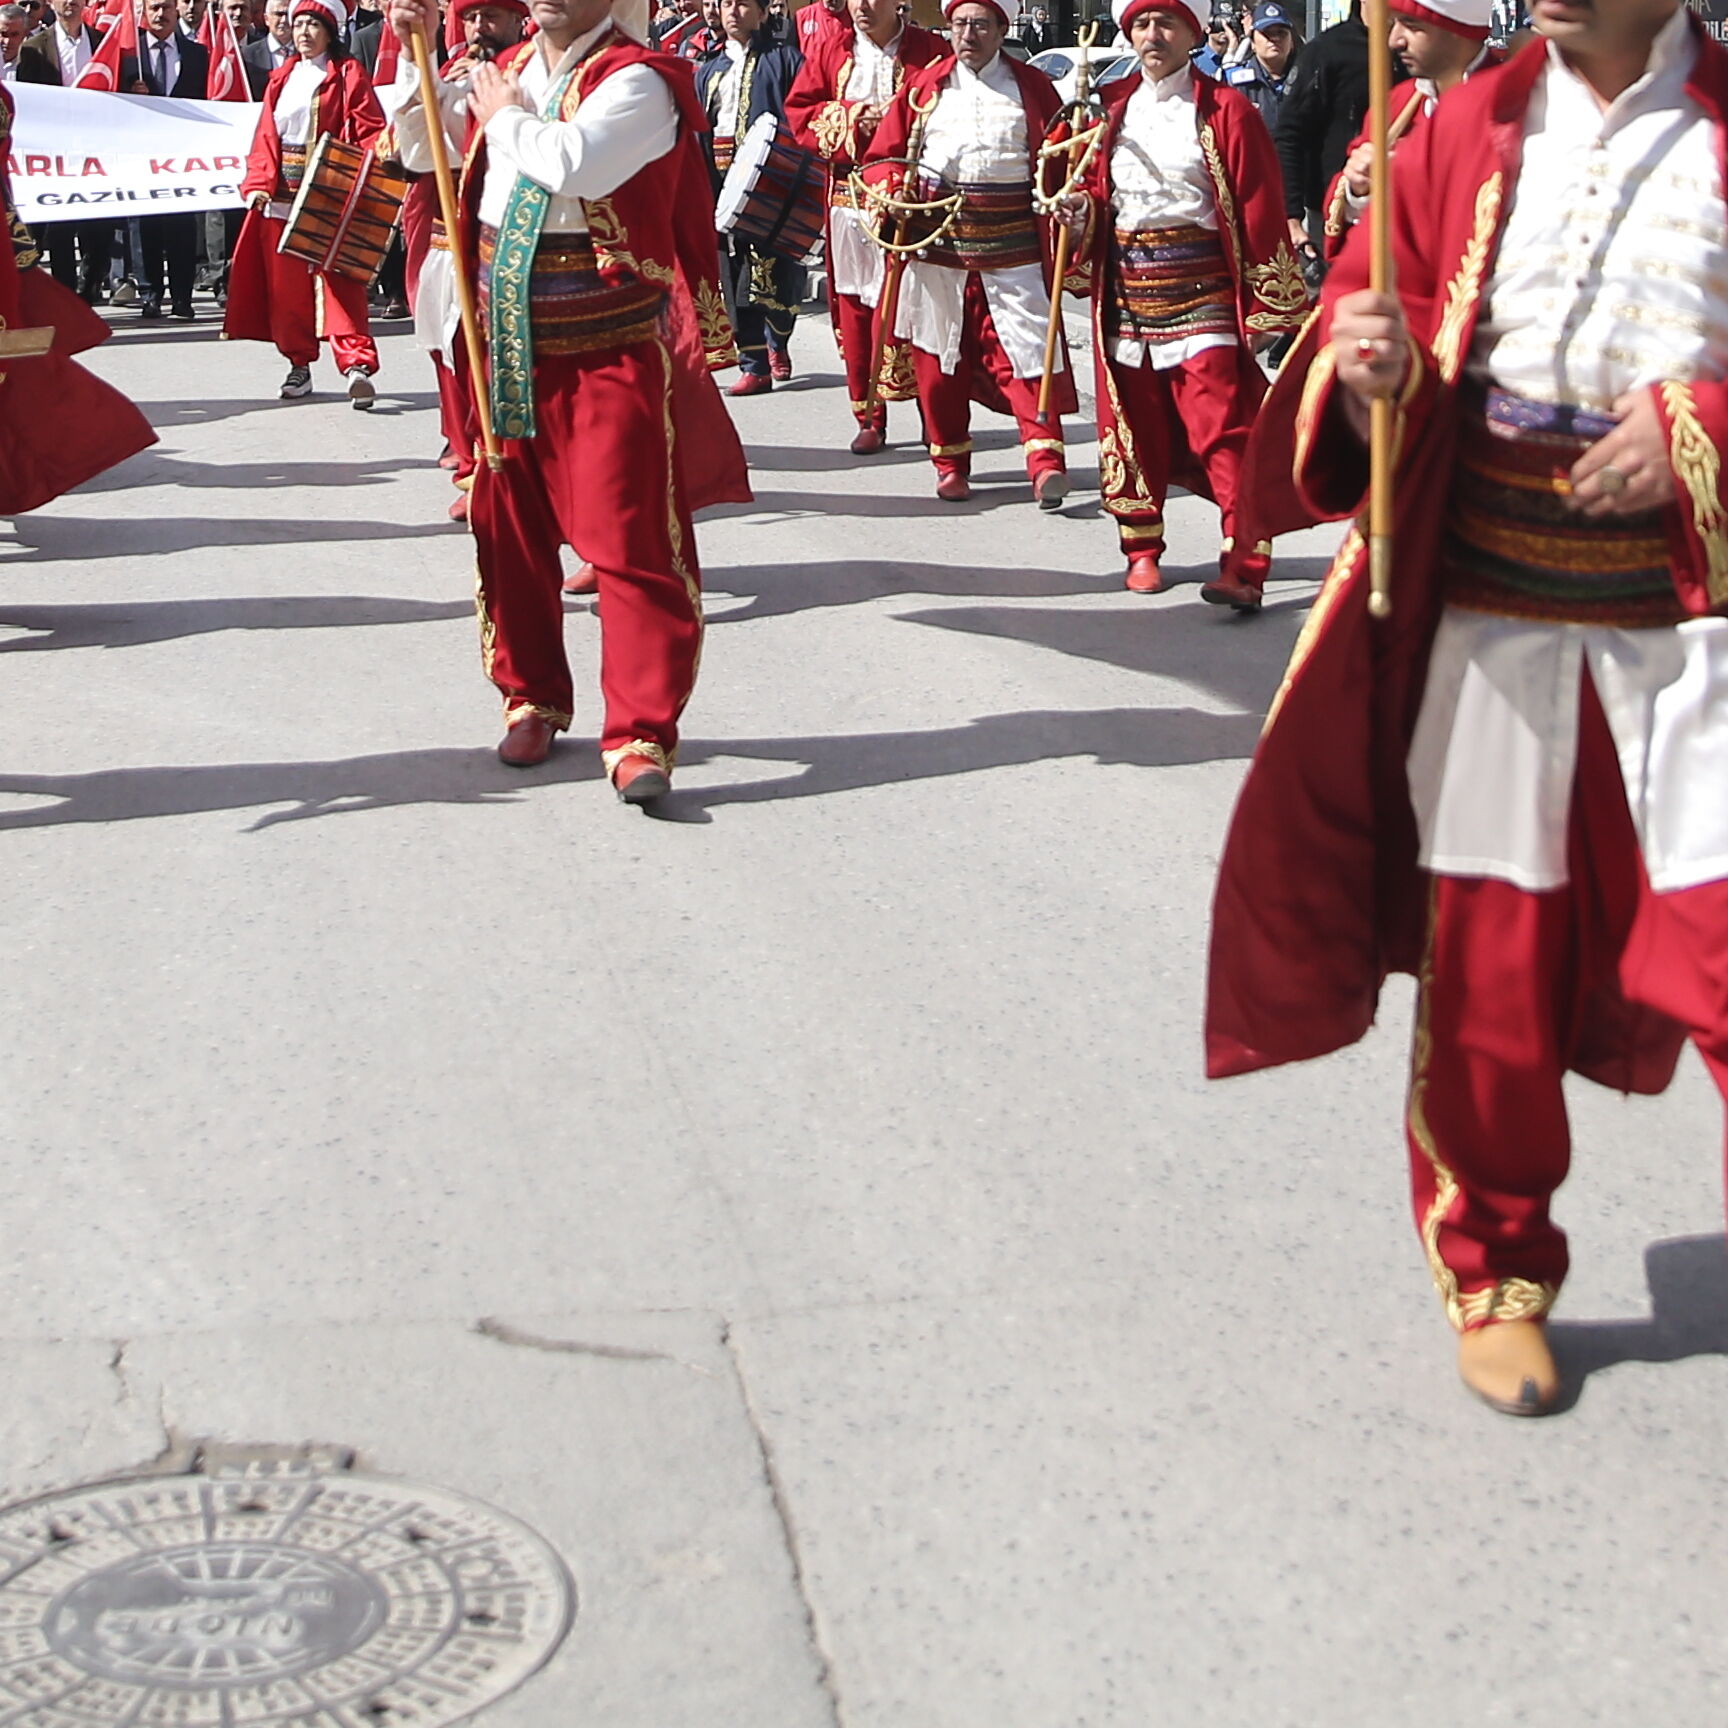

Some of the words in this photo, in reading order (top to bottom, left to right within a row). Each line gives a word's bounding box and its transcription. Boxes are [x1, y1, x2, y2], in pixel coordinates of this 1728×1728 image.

[7, 153, 109, 177] ARLA
[148, 155, 250, 175] KAR
[35, 186, 198, 206] GAZİLER
